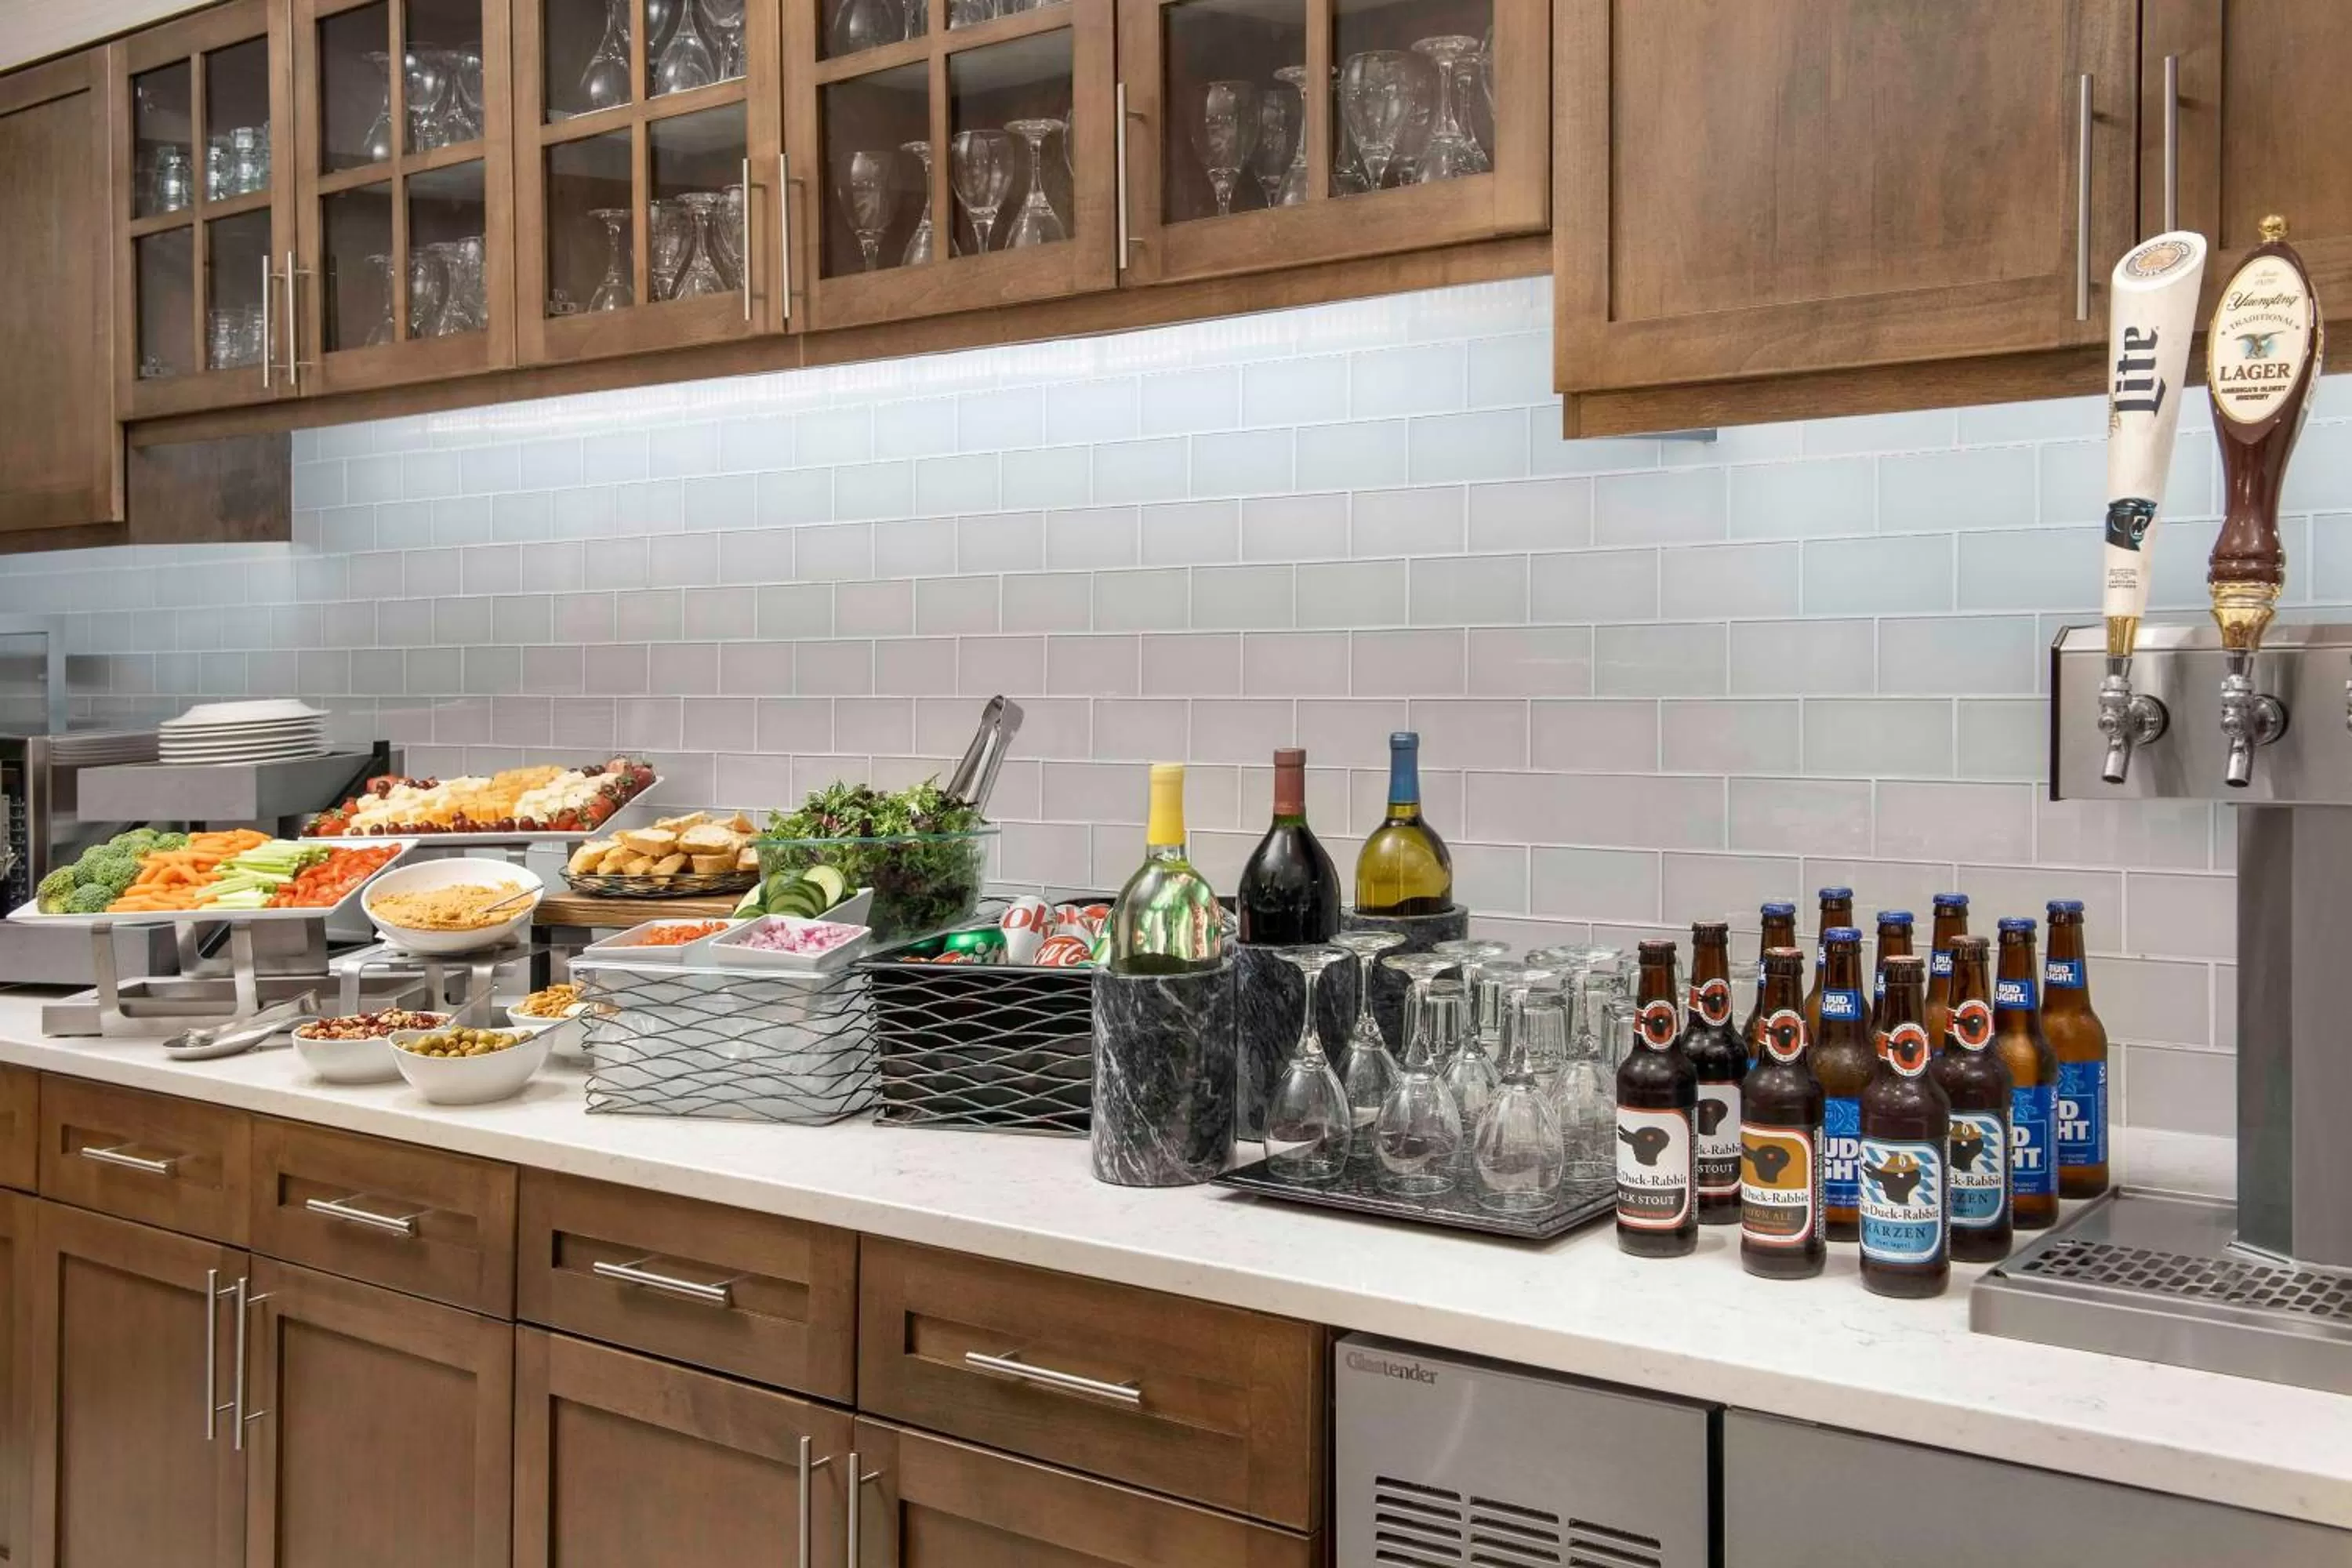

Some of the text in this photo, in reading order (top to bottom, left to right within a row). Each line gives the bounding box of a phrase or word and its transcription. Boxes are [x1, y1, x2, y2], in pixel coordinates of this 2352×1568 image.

[2227, 290, 2300, 311] Yuengling
[2229, 314, 2294, 330] TRADITIONAL
[2114, 326, 2166, 417] Lite
[2220, 363, 2291, 382] LAGER
[2048, 964, 2070, 973] BUD
[2045, 971, 2075, 982] LIGHT
[1998, 983, 2020, 994] BUD
[1825, 993, 1848, 1004] BUD
[1995, 992, 2027, 1004] LIGHT
[1822, 1003, 1853, 1014] LIGHT
[1825, 1137, 1859, 1159] UD
[1697, 1163, 1735, 1174] STOUT
[1638, 1194, 1675, 1205] STOUT
[1870, 1204, 1939, 1220] Duck-Rabbit
